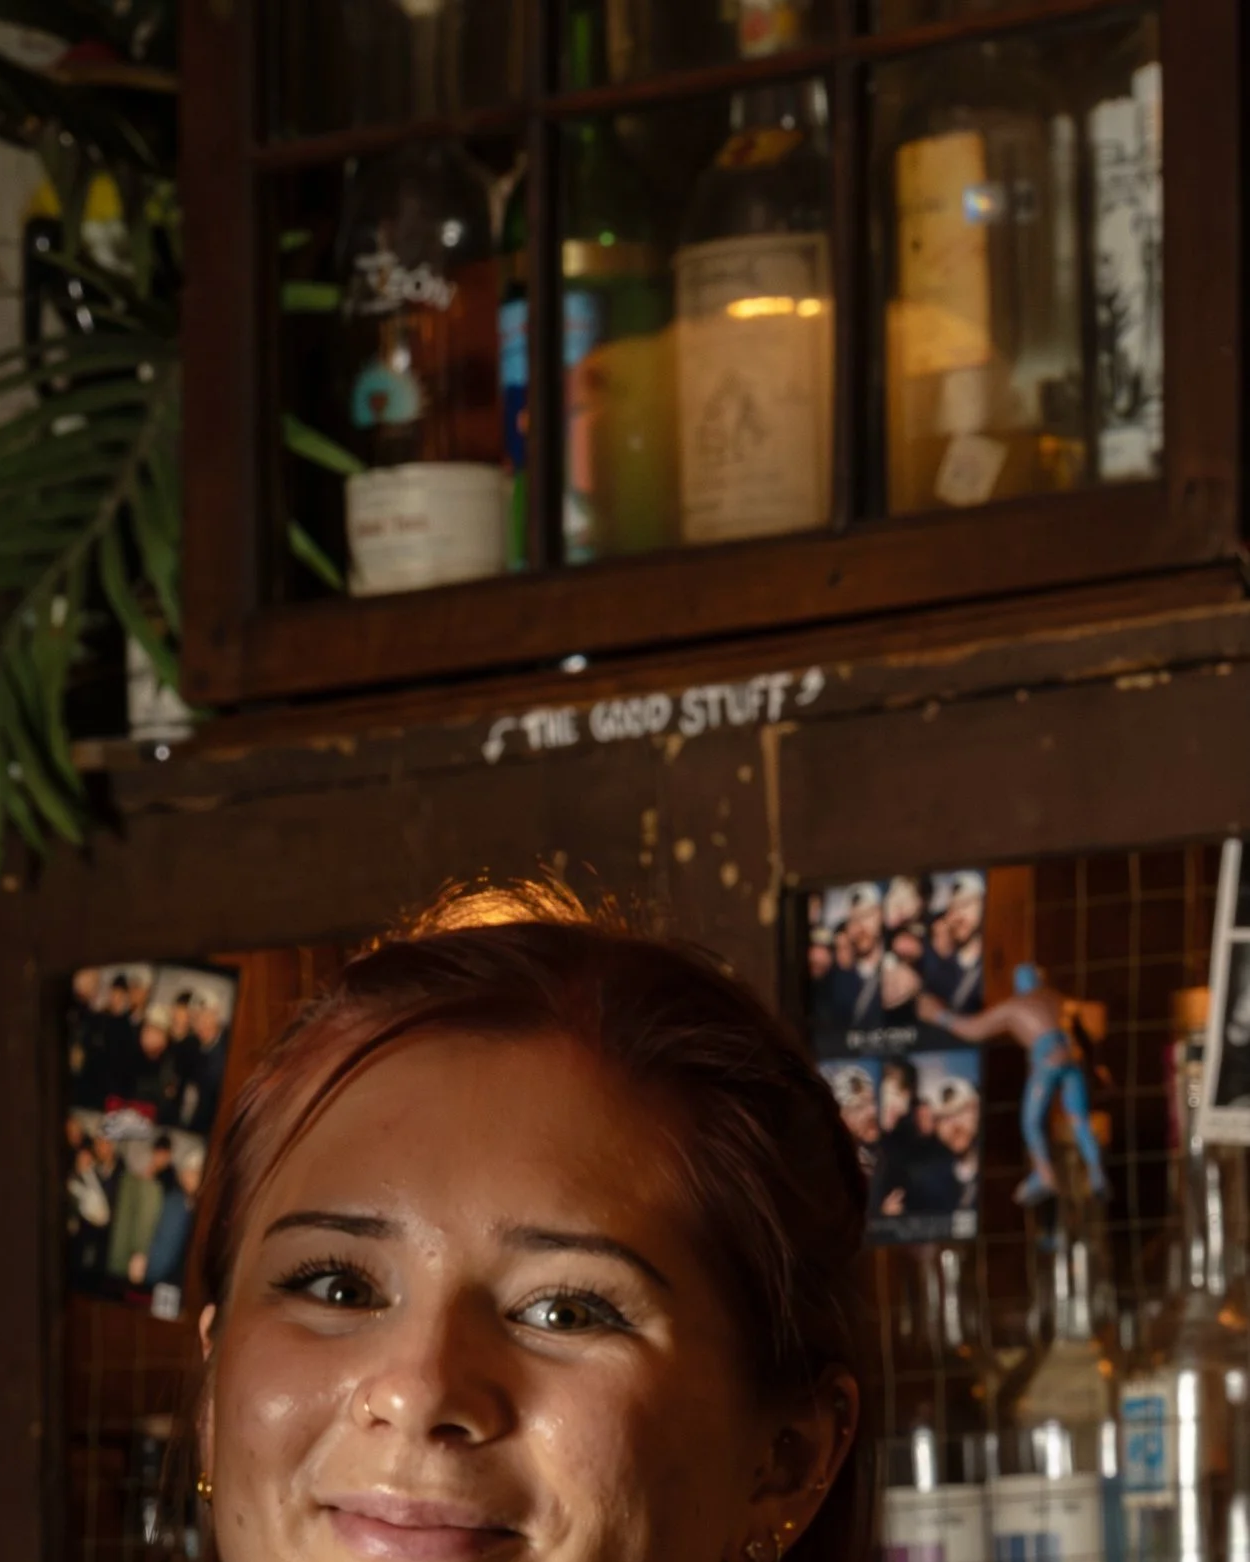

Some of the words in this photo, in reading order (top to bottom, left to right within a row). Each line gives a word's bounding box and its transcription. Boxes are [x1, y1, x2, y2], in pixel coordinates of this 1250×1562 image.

[520, 706, 579, 750] THE
[589, 692, 672, 742] GOOD
[679, 671, 792, 737] STUFF
